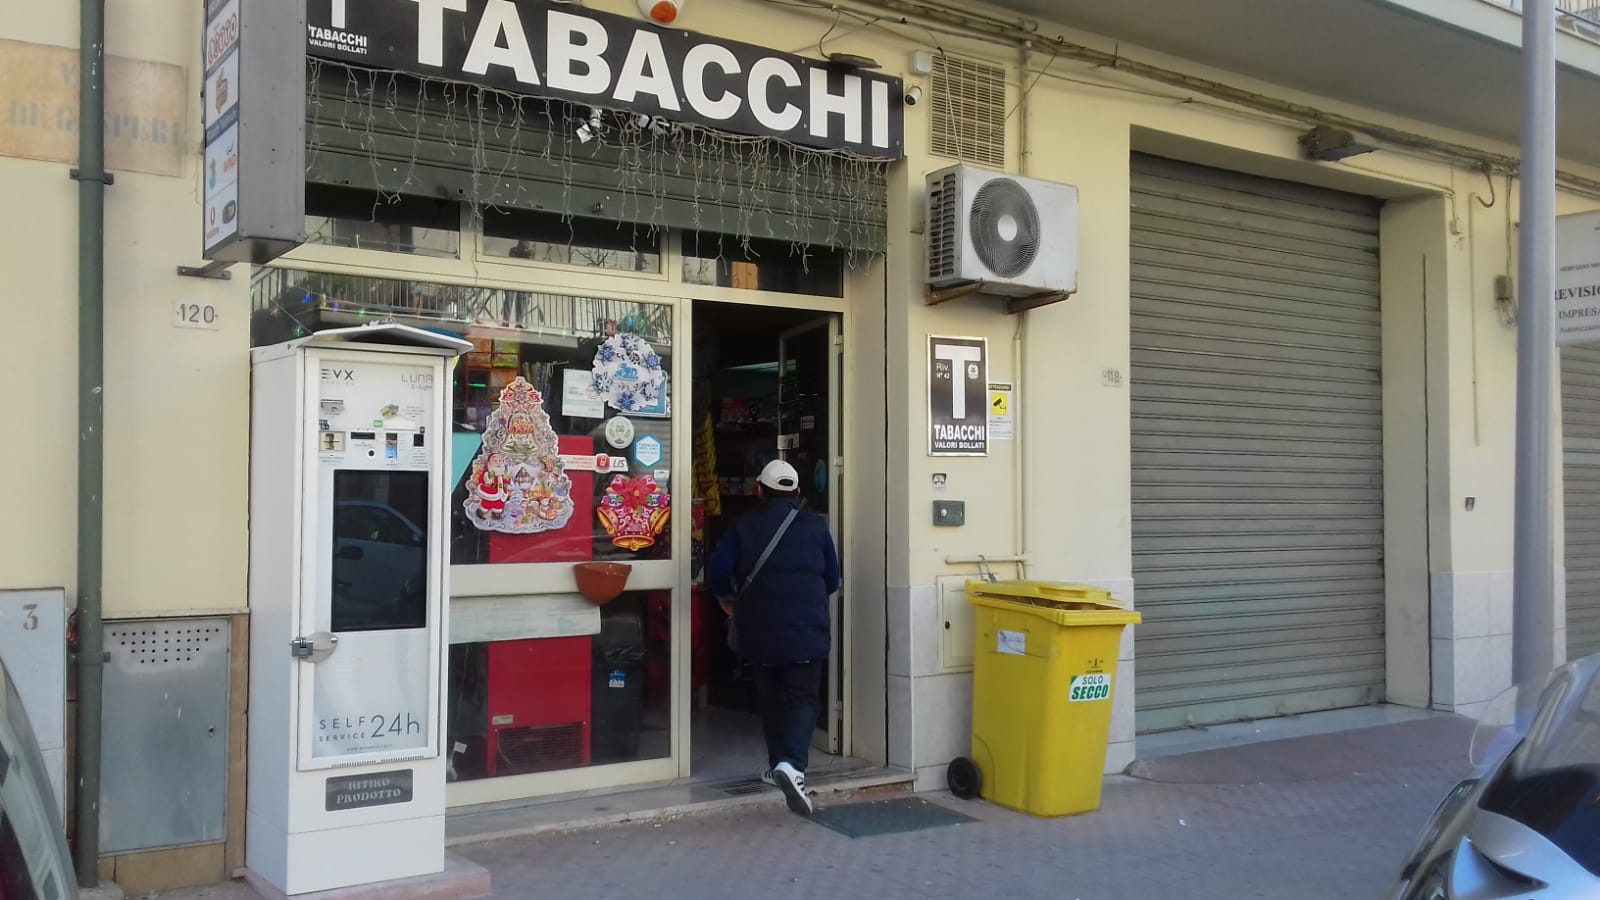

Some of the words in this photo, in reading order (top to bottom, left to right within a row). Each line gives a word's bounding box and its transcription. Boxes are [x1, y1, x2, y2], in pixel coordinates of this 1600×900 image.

[309, 25, 367, 48] TABACCHI
[309, 38, 336, 49] VALORI
[336, 43, 367, 55] BOLLATI
[412, 0, 889, 149] TABACCHI
[180, 303, 215, 324] 120
[1559, 306, 1600, 319] IMPRES
[935, 344, 981, 419] T
[934, 424, 985, 441] TABACCHI
[934, 441, 958, 449] VALORI
[959, 441, 985, 449] BOLLATI
[23, 603, 38, 631] 3
[1082, 675, 1104, 685] SOLO
[1071, 684, 1109, 700] SECCO
[319, 716, 366, 730] SELF
[370, 711, 420, 738] 24h
[319, 732, 366, 742] SERVICE
[336, 787, 401, 804] PRODOTTO
